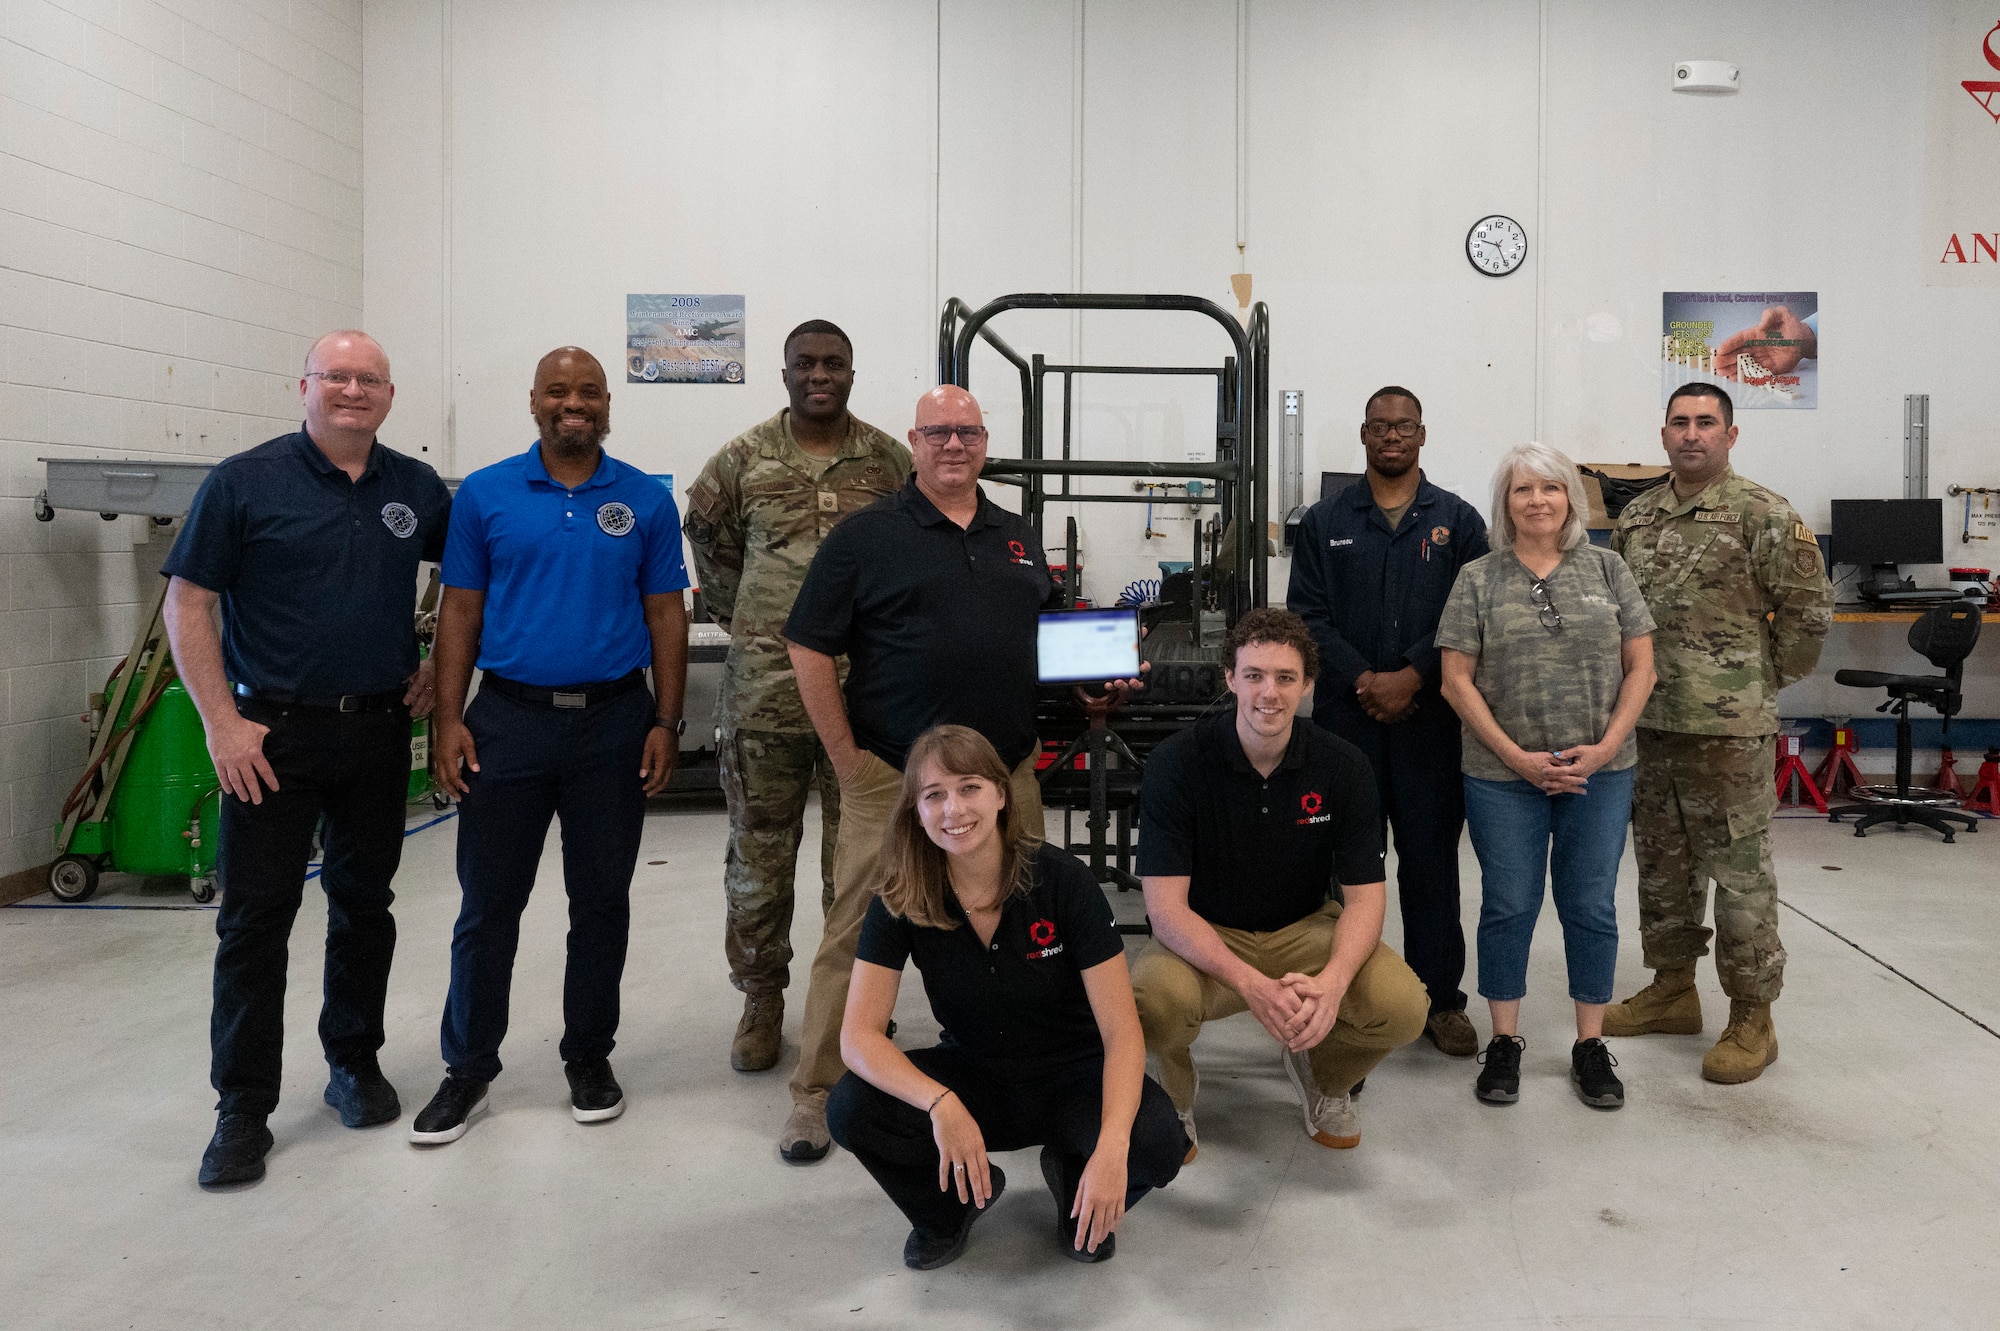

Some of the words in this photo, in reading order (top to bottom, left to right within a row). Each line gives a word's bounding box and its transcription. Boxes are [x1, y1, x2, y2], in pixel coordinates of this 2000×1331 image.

[1495, 221, 1504, 229] 12
[1477, 231, 1487, 239] 10
[671, 297, 701, 307] 2008
[629, 310, 673, 318] Maintenance
[674, 310, 720, 318] Effectiveness
[721, 310, 743, 318] Award
[1669, 321, 1714, 329] GROUNDED
[675, 328, 699, 337] AMC
[668, 338, 708, 347] Maintenance
[709, 338, 741, 348] Squadron
[1296, 813, 1331, 825] redshred
[1025, 942, 1064, 960] redshred
